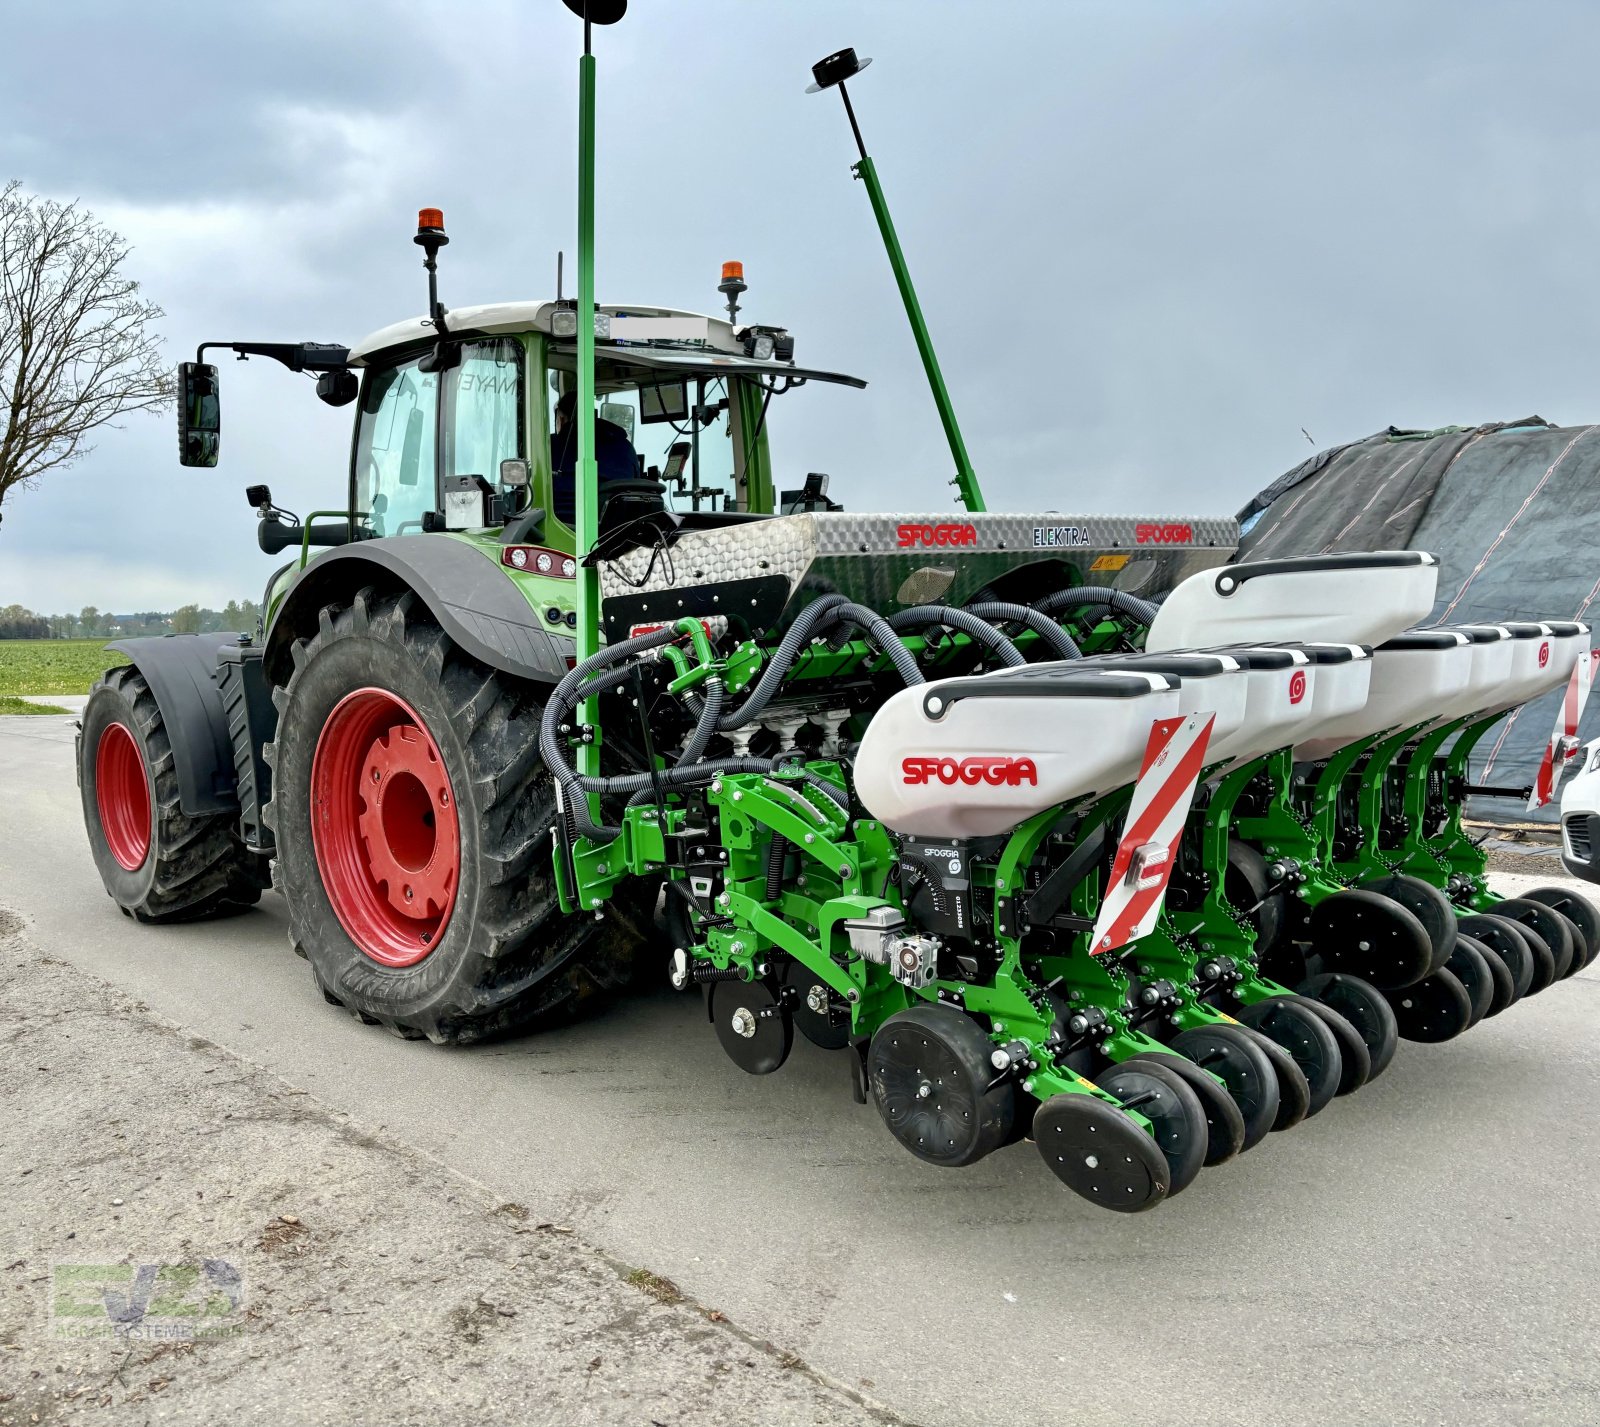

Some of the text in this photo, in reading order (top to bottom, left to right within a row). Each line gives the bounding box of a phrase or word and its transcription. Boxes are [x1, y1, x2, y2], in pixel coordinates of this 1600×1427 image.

[897, 524, 977, 547] SFOGGIA
[1032, 526, 1091, 547] ELEKTRA
[1136, 523, 1193, 544] SFOGGIA
[902, 757, 1037, 786] SFOGGIA
[924, 848, 959, 858] SFOGGIA
